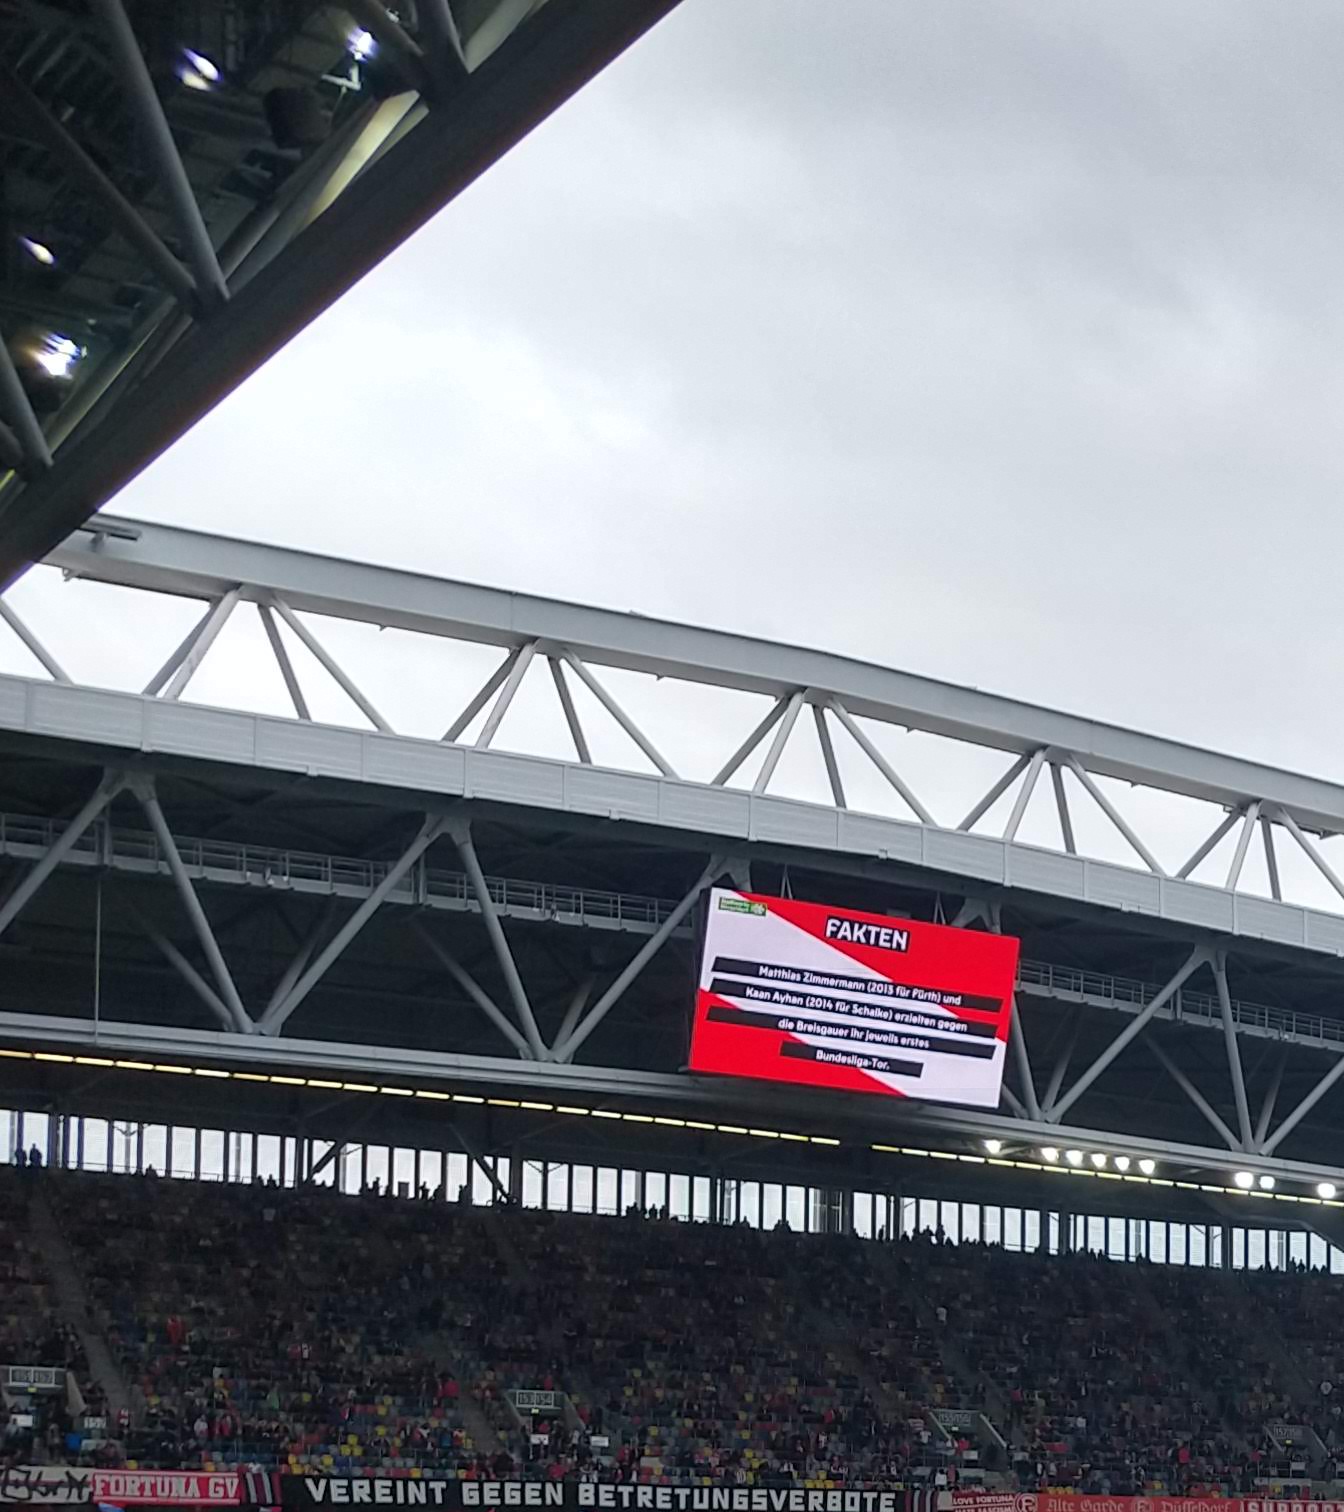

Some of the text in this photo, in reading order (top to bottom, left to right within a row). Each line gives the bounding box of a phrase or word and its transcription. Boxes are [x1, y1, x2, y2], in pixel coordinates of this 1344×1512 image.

[825, 918, 909, 951] FAKTEN
[759, 965, 801, 980] Matthias
[803, 972, 865, 991] Zimmermann
[895, 986, 911, 998] für
[943, 995, 962, 1006] und
[746, 986, 968, 1032] Kaan Ayhan (2014 für Schalke) erzielten gegen
[778, 1018, 795, 1031] die
[850, 1028, 864, 1040] ihr
[865, 1030, 899, 1045] jeweils
[901, 1037, 930, 1049] erstes
[815, 1050, 891, 1070] Bundesliga-Tor.
[95, 1472, 200, 1498] FORTUNA
[304, 1477, 447, 1505] VEREINT
[461, 1481, 565, 1507] GEGEN
[953, 1494, 1014, 1506] LOVE FORTUNA
